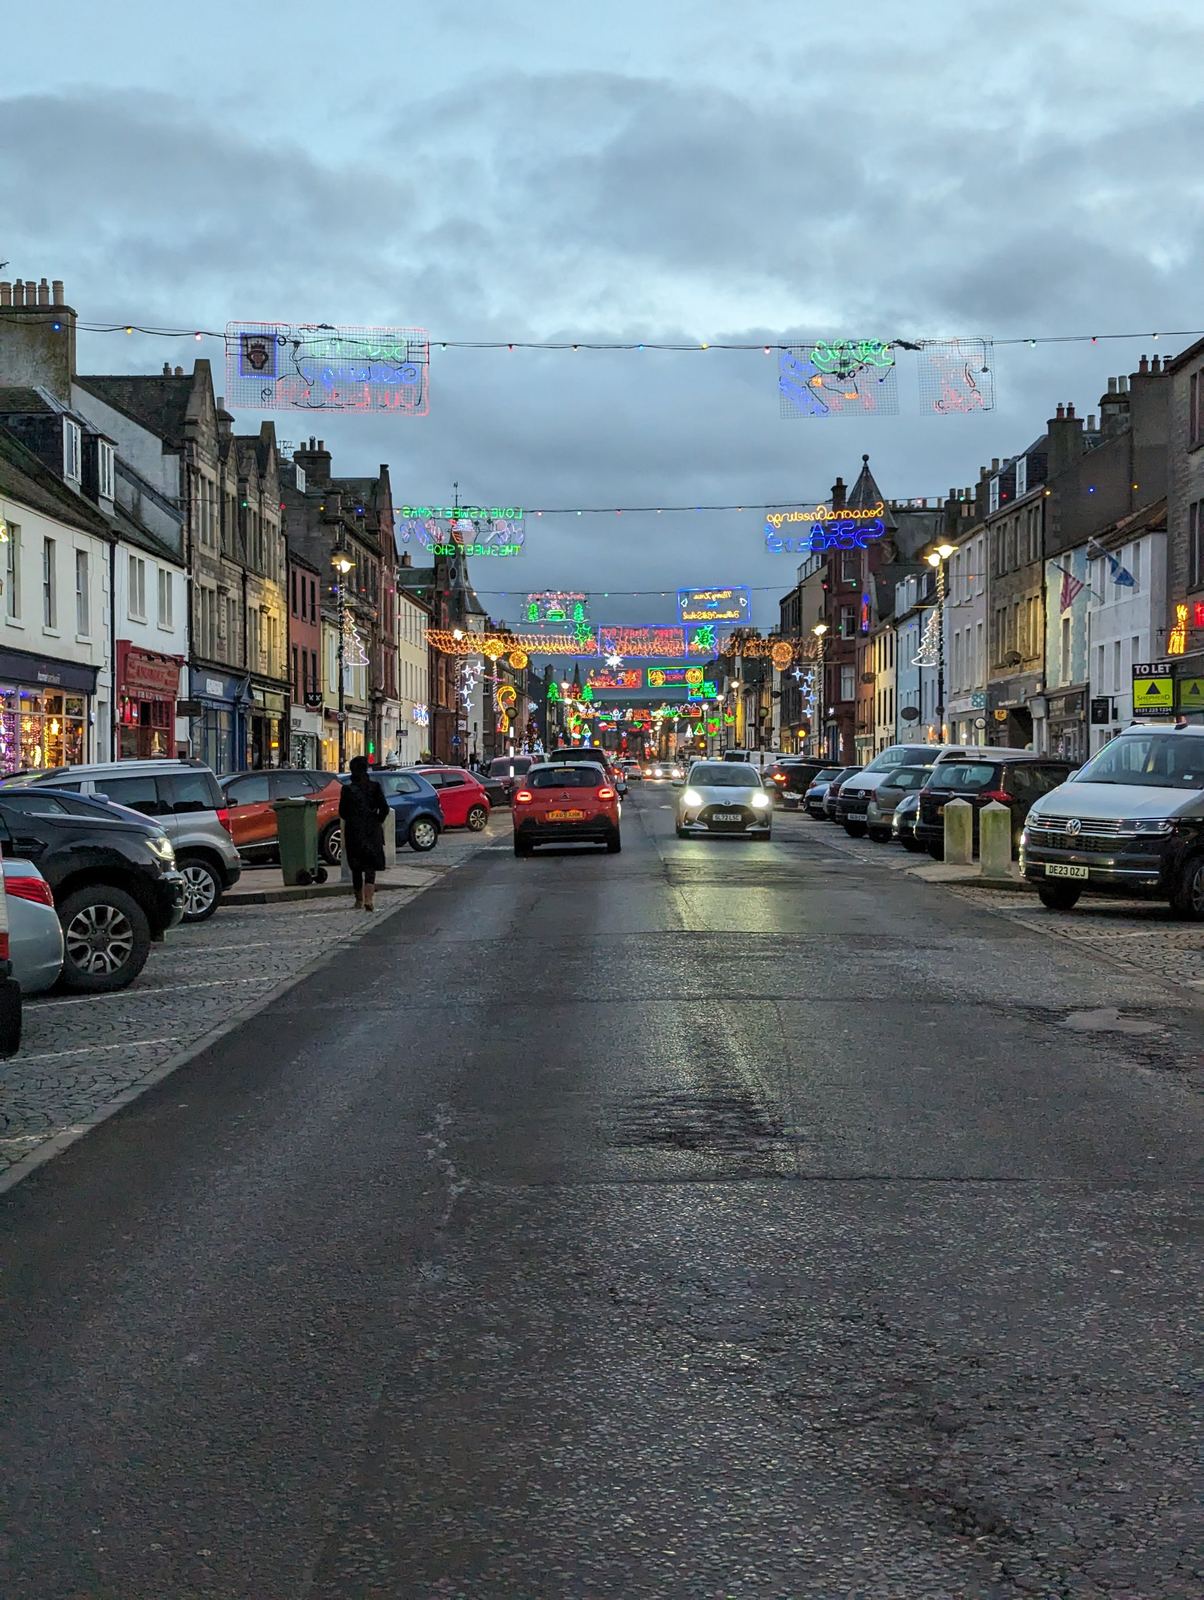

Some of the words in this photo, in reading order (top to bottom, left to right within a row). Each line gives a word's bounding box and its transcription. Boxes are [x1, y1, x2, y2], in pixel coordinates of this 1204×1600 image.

[1134, 665, 1150, 674] TO
[1151, 664, 1172, 673] LET
[1049, 865, 1069, 876] DE23
[1069, 867, 1086, 877] OZJ
